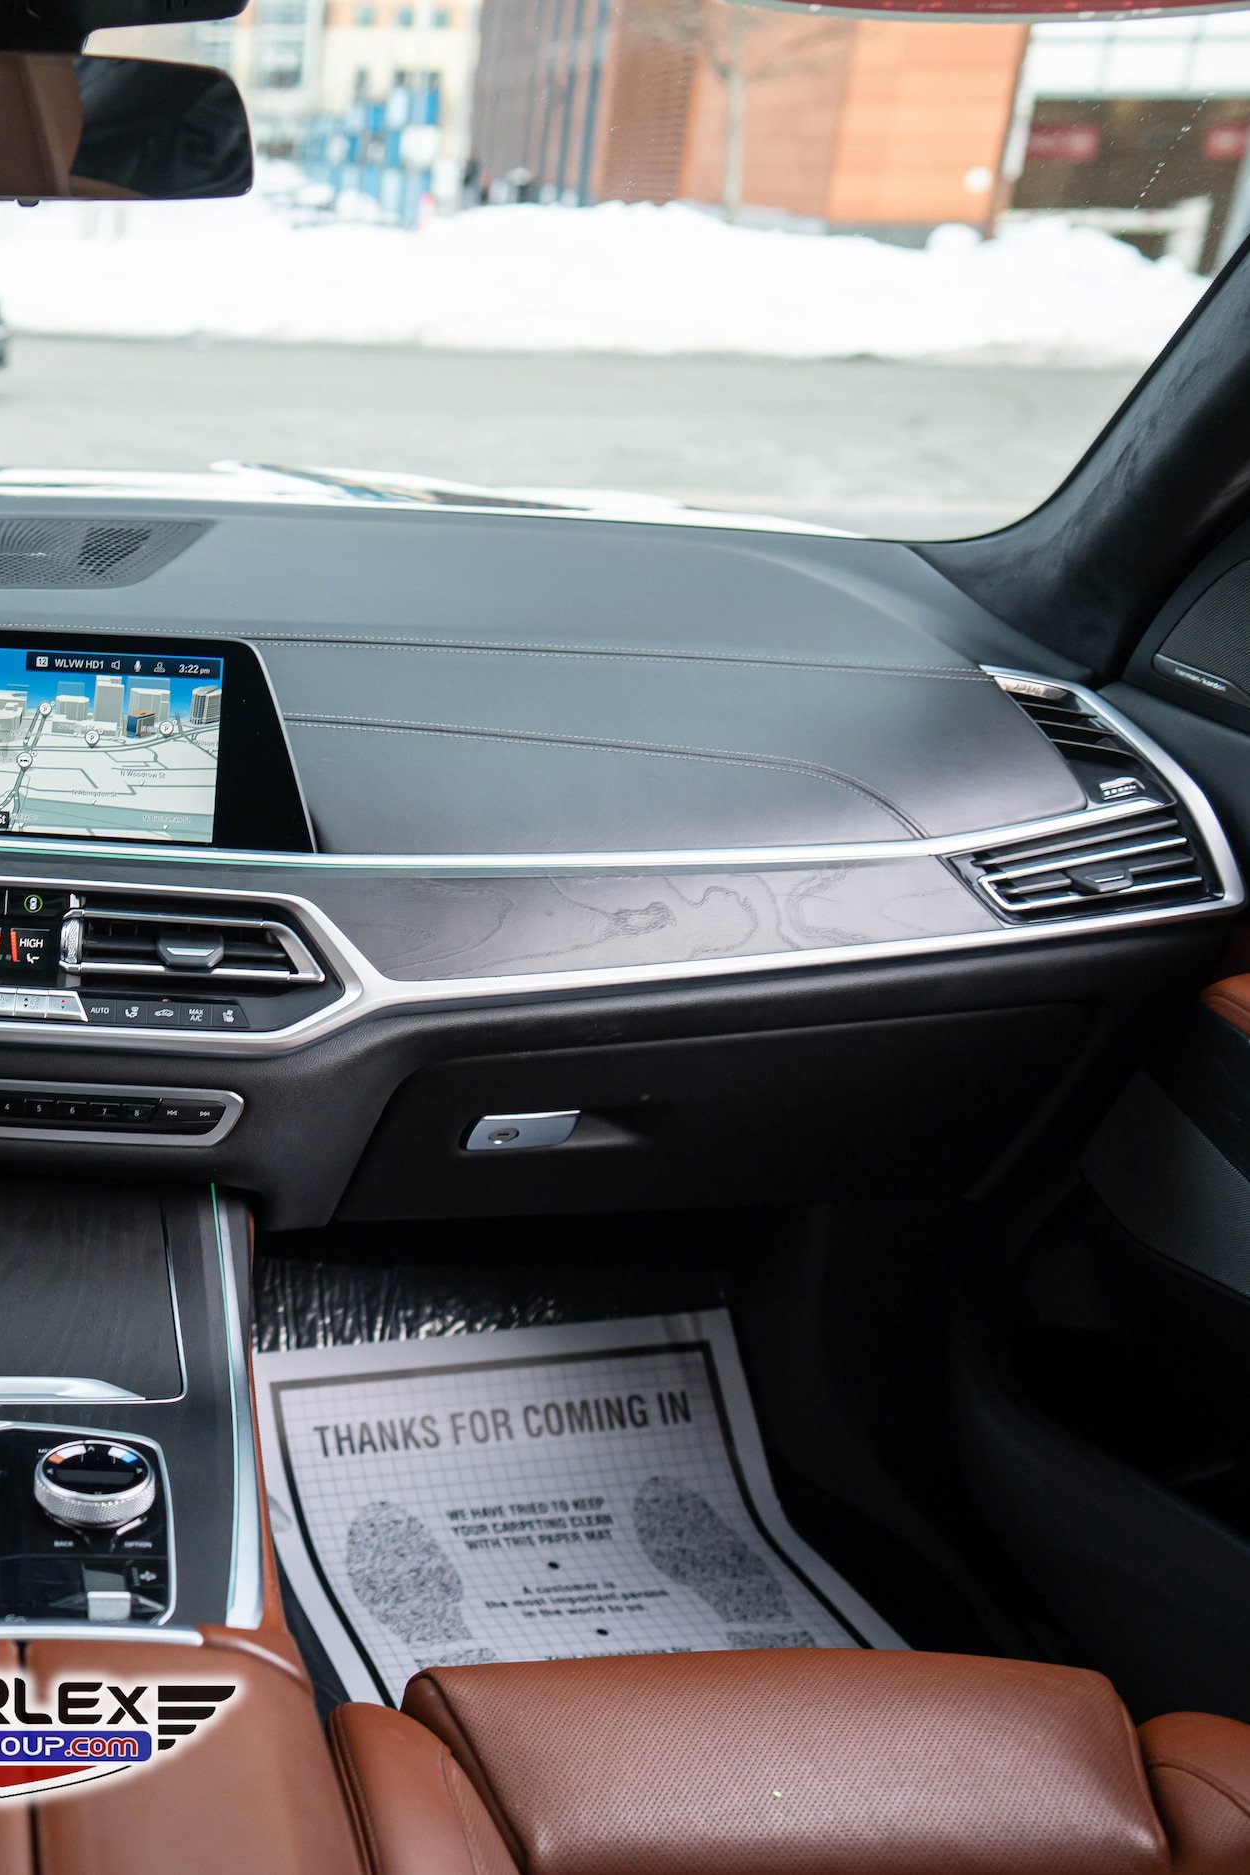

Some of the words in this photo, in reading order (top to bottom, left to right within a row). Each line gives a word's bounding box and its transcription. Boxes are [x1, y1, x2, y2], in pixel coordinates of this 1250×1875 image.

[37, 657, 48, 667] 12
[54, 658, 84, 669] WLVW
[85, 659, 104, 670] HD1
[179, 664, 199, 674] 3:22
[199, 667, 210, 675] pm
[19, 938, 44, 949] HIGH
[90, 1006, 110, 1015] AUTO
[189, 1008, 204, 1016] MAX
[190, 1014, 203, 1023] A/C
[4, 1103, 10, 1111] 4
[36, 1105, 42, 1113] 5
[69, 1107, 76, 1115] 6
[102, 1108, 108, 1116] 7
[134, 1110, 140, 1118] 8
[313, 1414, 442, 1459] THANKS
[450, 1408, 515, 1446] FOR
[523, 1394, 649, 1440] COMING
[657, 1390, 692, 1425] IN
[446, 1508, 466, 1521] WE
[470, 1505, 506, 1520] HAVE
[508, 1501, 549, 1517] TRIED
[552, 1499, 570, 1513] TO
[572, 1496, 605, 1511] KEEP
[452, 1523, 490, 1537] YOUR
[492, 1517, 568, 1534] CARPETING
[569, 1514, 614, 1528] CLEAN
[54, 1540, 74, 1548] BACK
[124, 1540, 153, 1548] OPTION
[464, 1538, 502, 1551] WITH
[505, 1534, 536, 1548] THIS
[538, 1531, 582, 1546] PAPER
[584, 1529, 613, 1542] MAT
[522, 1585, 532, 1595] A
[536, 1582, 599, 1594] customer
[603, 1580, 617, 1590] is
[485, 1599, 509, 1610] the
[512, 1596, 546, 1608] most
[550, 1591, 617, 1605] important
[620, 1588, 669, 1601] person
[538, 1606, 564, 1617] the
[607, 1603, 625, 1613] to
